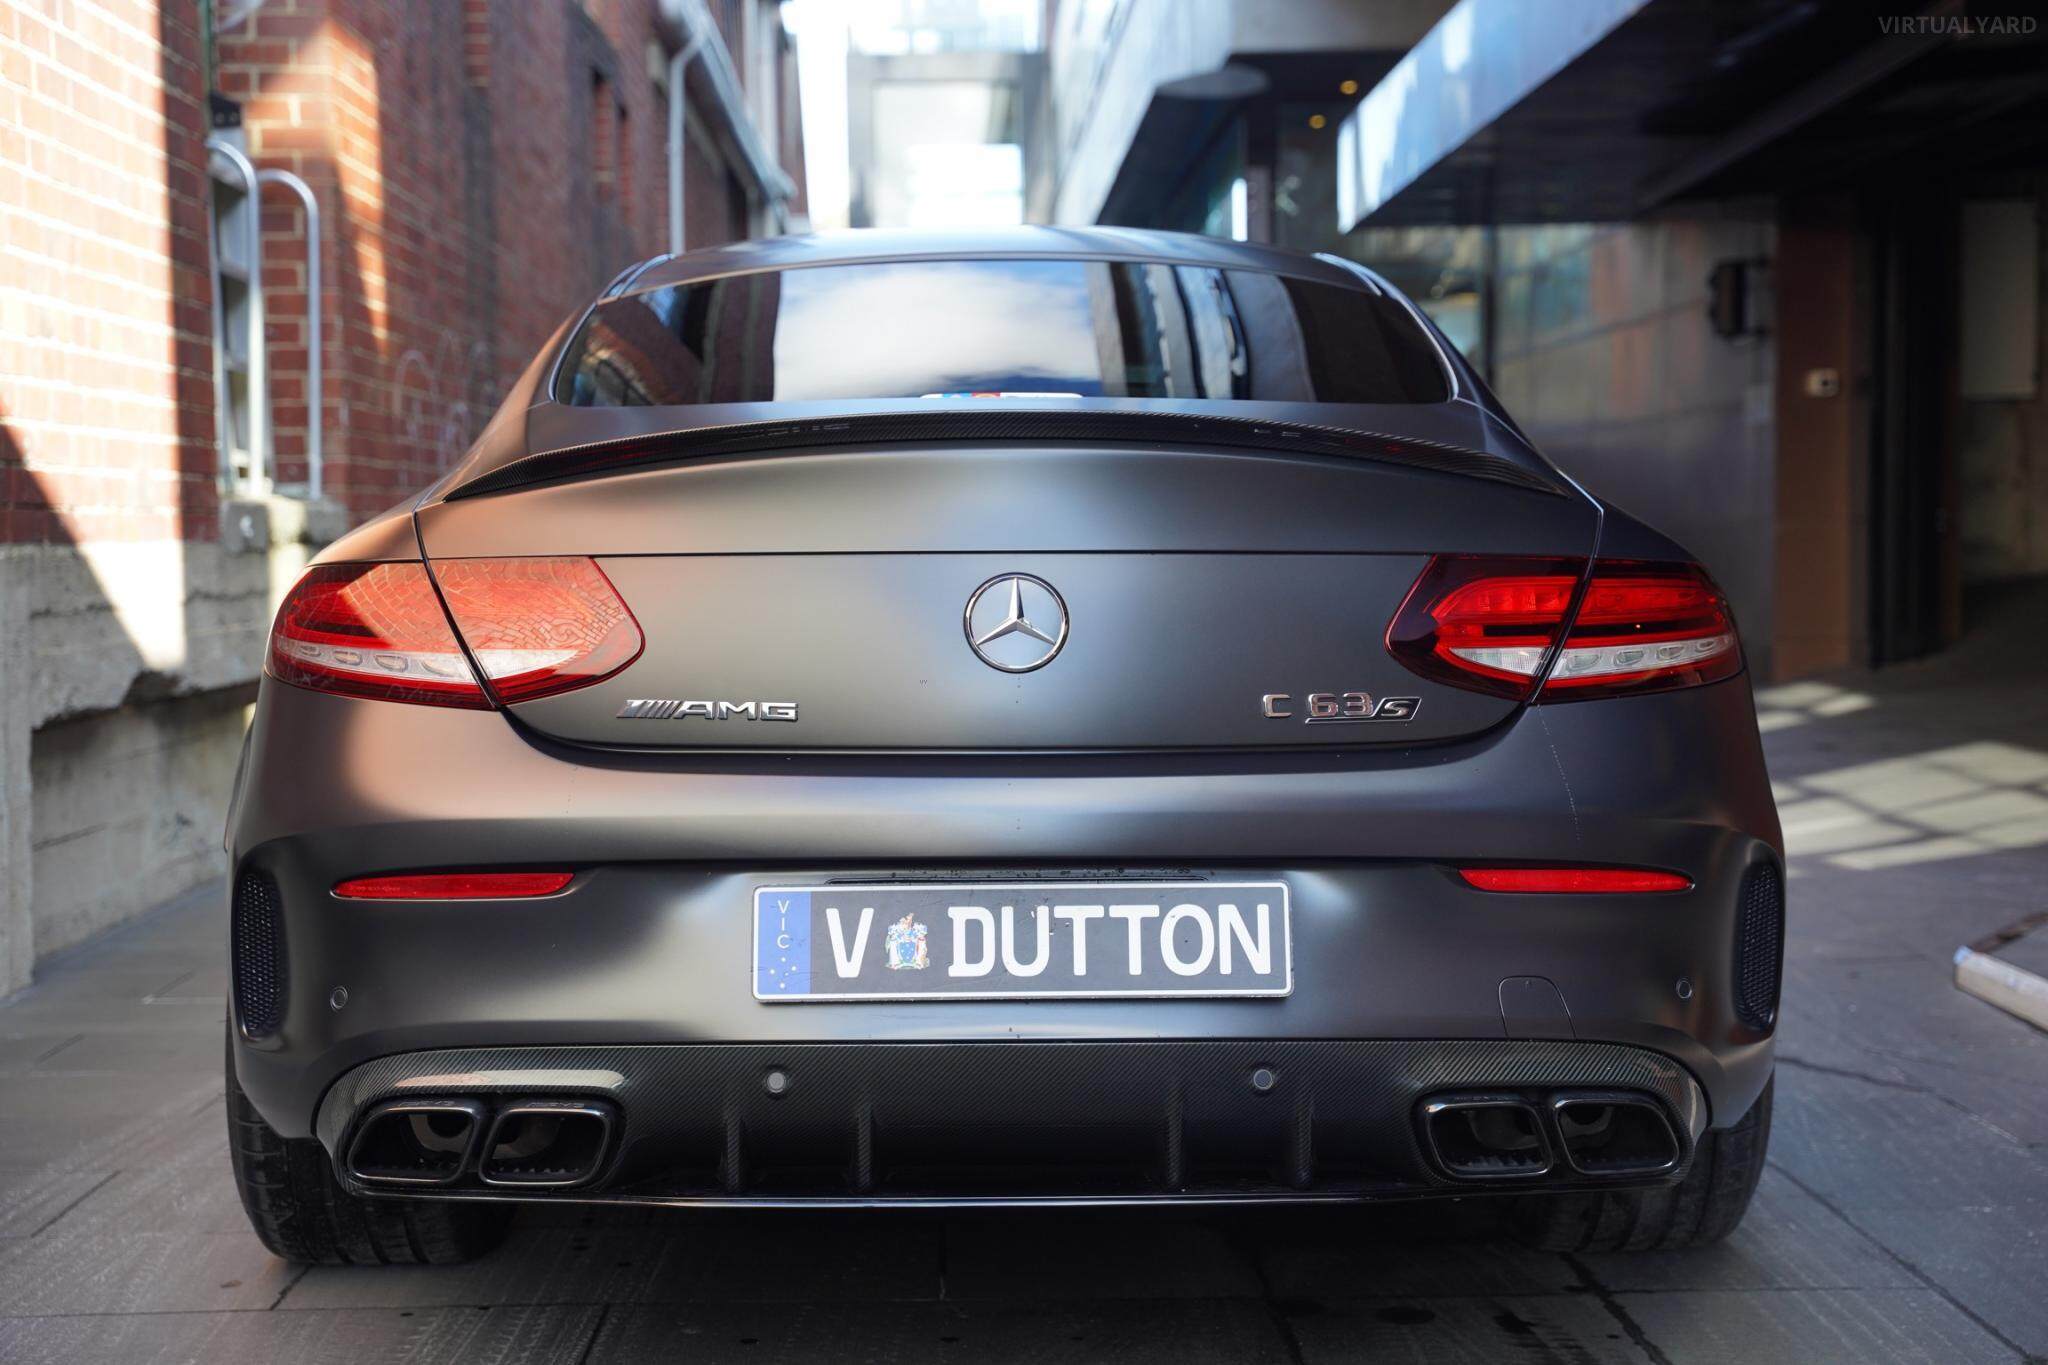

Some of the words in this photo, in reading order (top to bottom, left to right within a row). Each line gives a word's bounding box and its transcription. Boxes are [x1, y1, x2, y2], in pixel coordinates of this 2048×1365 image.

[673, 700, 798, 722] AMG
[1262, 693, 1293, 718] C
[776, 899, 791, 949] VIC
[826, 907, 875, 978] V
[947, 903, 1270, 977] DUTTON
